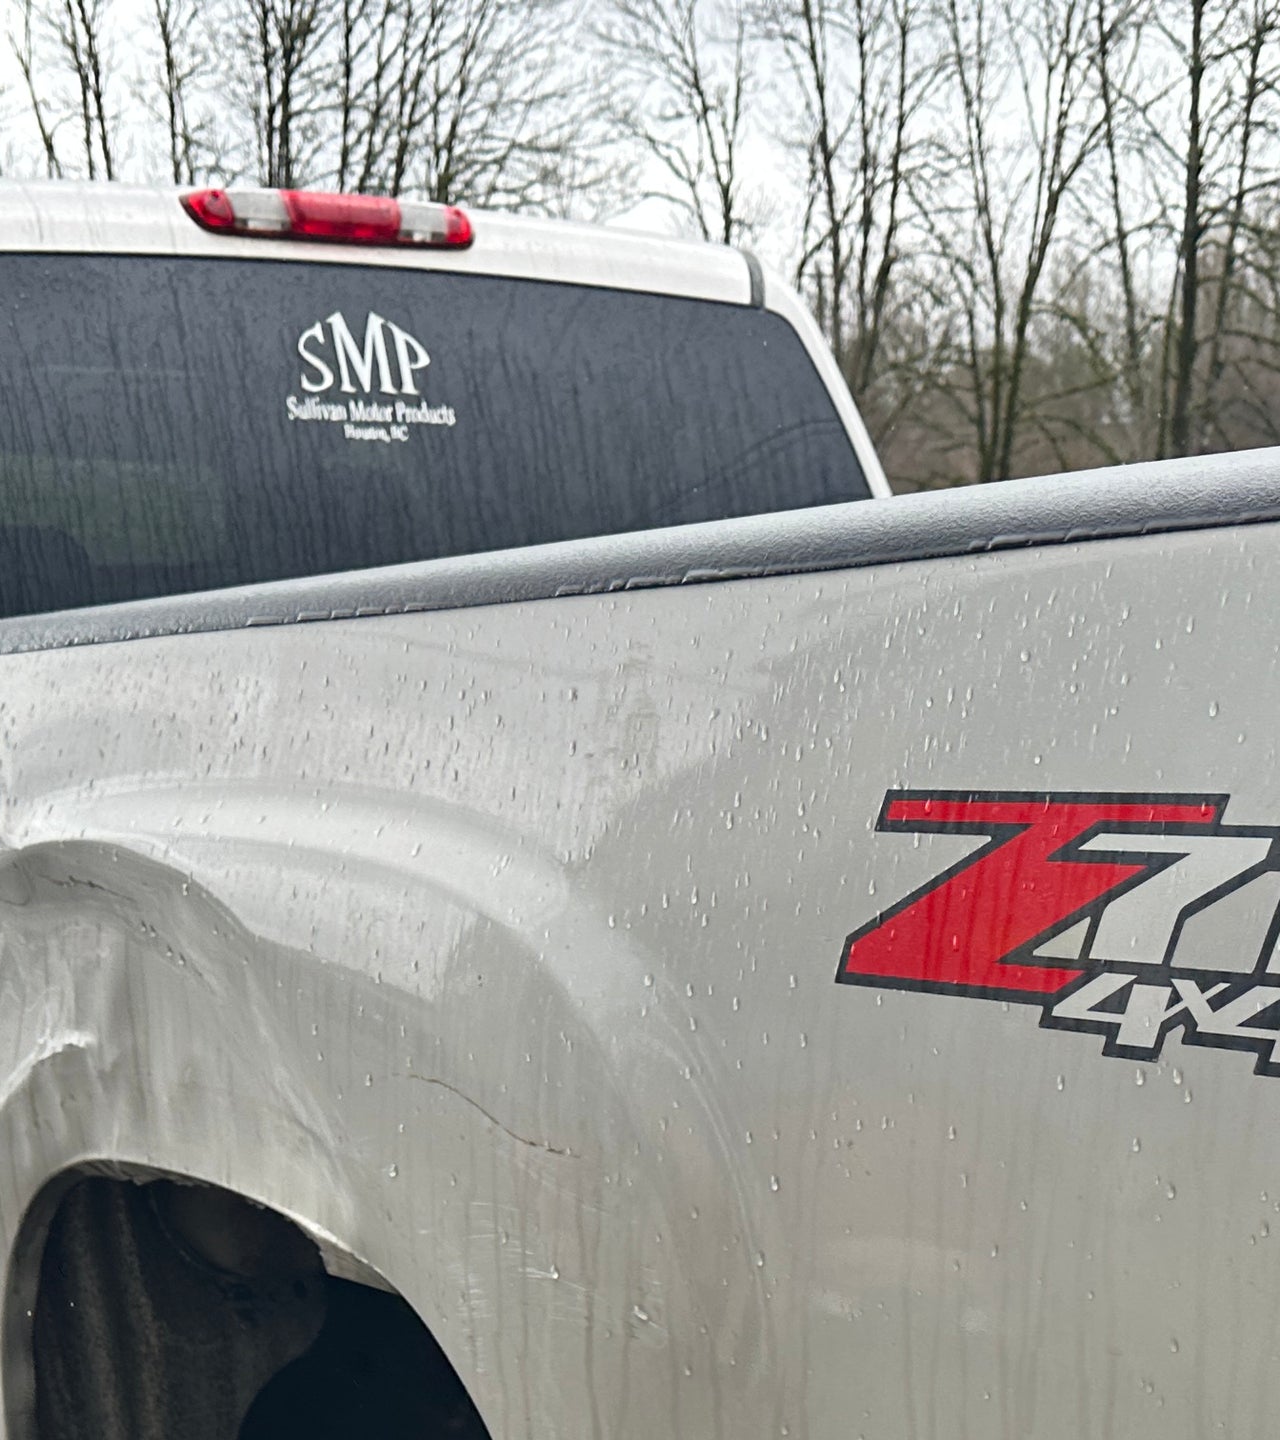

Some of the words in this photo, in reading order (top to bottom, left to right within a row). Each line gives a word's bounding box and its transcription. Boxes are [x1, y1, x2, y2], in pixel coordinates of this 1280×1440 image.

[297, 310, 431, 396] SMP
[286, 395, 347, 421] Sullivan
[348, 399, 394, 423] Motor
[395, 400, 457, 427] Products
